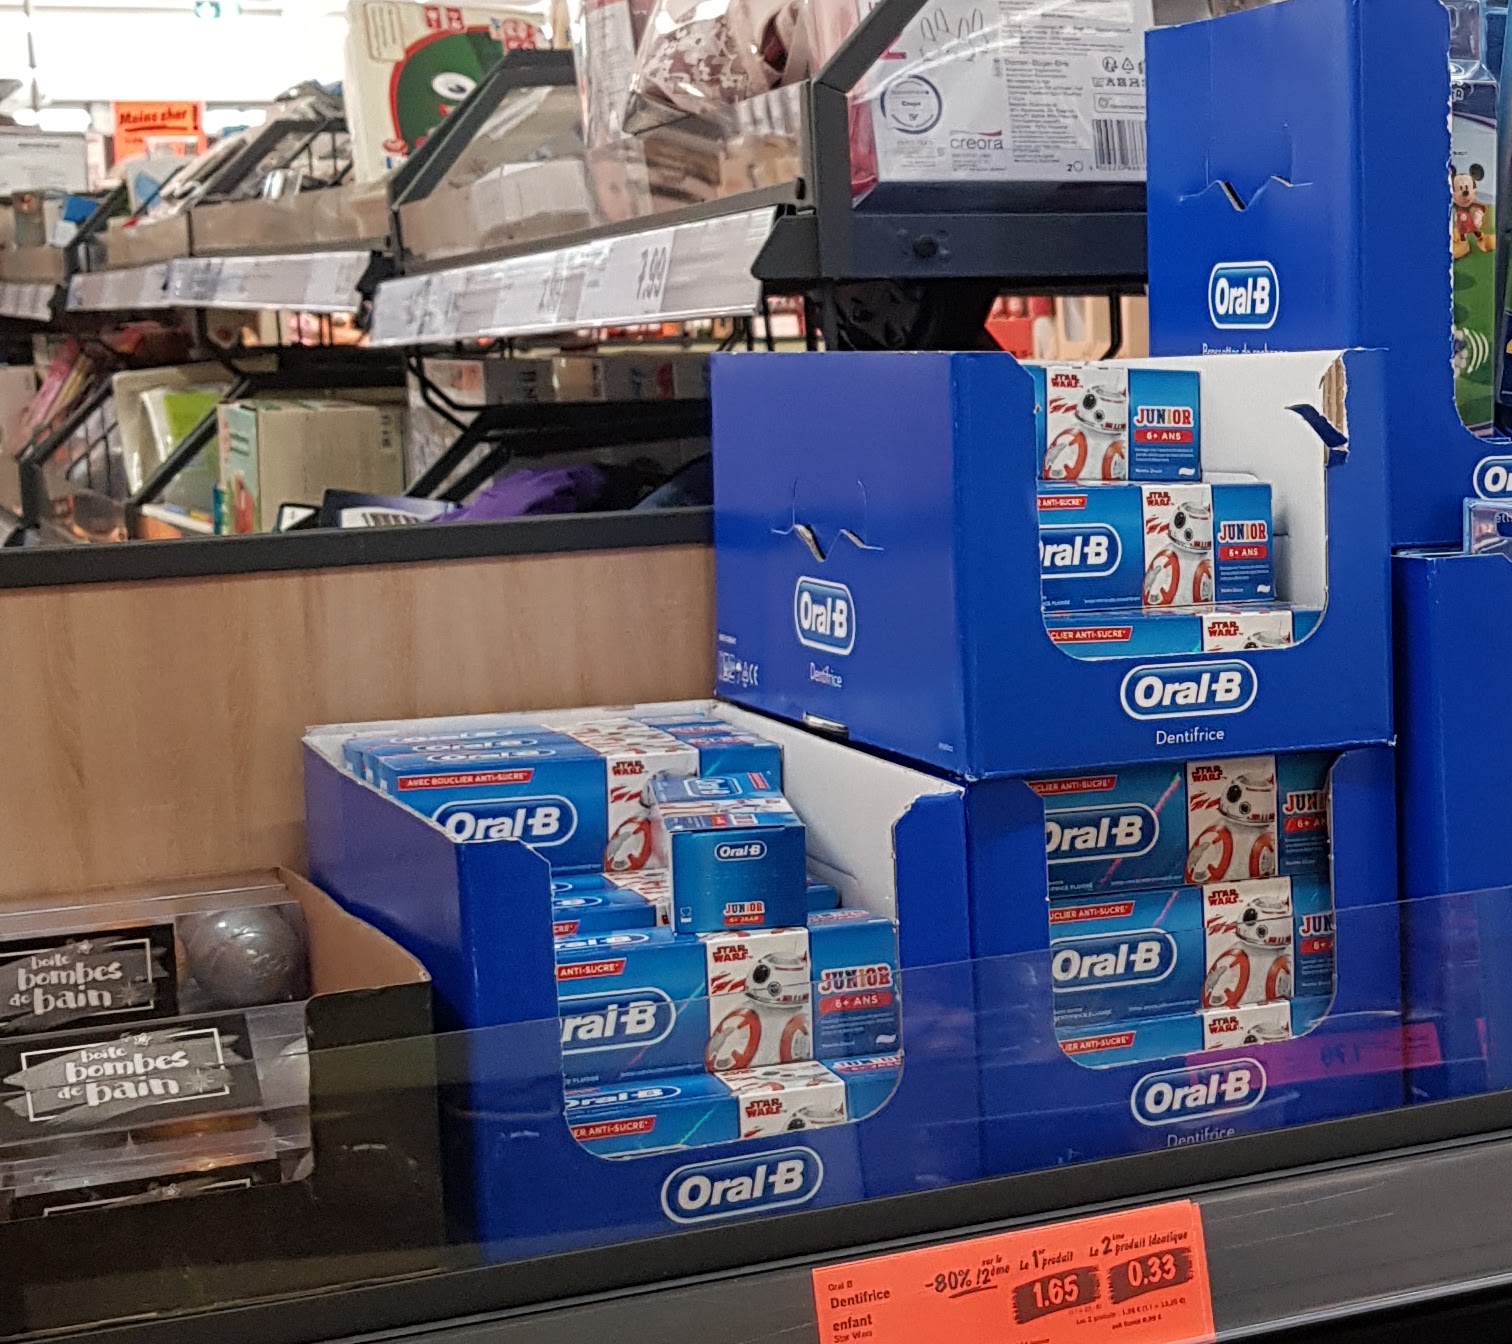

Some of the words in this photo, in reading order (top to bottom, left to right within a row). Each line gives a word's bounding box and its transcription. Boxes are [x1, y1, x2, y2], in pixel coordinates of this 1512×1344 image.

[951, 136, 1004, 150] creora
[1215, 275, 1271, 313] Oral-B
[1136, 408, 1192, 426] JUNIOR
[1162, 432, 1182, 441] ANS
[1219, 522, 1268, 540] JUNIOR
[1041, 535, 1109, 567] ral-B
[1242, 548, 1259, 557] ANS
[800, 591, 848, 639] Oral-B
[1208, 627, 1239, 637] WARS
[1210, 621, 1238, 629] STAR
[1135, 672, 1242, 709] Oral-B
[1157, 727, 1224, 746] Dentifrice
[612, 766, 645, 775] WARS
[614, 761, 642, 769] STAR
[1193, 765, 1222, 774] STAR
[407, 777, 431, 787] AVEC
[432, 773, 473, 785] BOUCLIER
[1191, 772, 1223, 782] WARS
[445, 805, 561, 841] Oral-B
[719, 843, 762, 857] Oral-B
[1208, 895, 1239, 905] WARS
[1210, 889, 1239, 897] STAR
[725, 902, 764, 915] JUNIOR
[713, 951, 749, 962] WARS
[715, 945, 747, 953] STAR
[1052, 941, 1161, 981] Oral-B
[18, 961, 123, 992] bombes
[821, 967, 891, 991] JUNIOR
[9, 992, 32, 1006] de
[33, 985, 112, 1015] bain
[854, 995, 878, 1006] ANS
[562, 1000, 657, 1042] ral-B
[1208, 1023, 1239, 1033] WARS
[1211, 1017, 1238, 1025] STAR
[66, 1050, 189, 1084] bombes
[57, 1085, 83, 1101] de
[86, 1075, 180, 1107] bain
[1144, 1069, 1251, 1114] Oral-B
[745, 1105, 783, 1117] WARS
[748, 1098, 782, 1107] STAR
[1167, 1127, 1235, 1147] Dentifrice
[678, 1152, 805, 1210] Oral-B
[1127, 1255, 1176, 1288] 0.33
[924, 1270, 972, 1293] -80%
[830, 1289, 891, 1309] Dentifrice
[1033, 1275, 1080, 1308] 1.65
[833, 1314, 872, 1332] enfant
